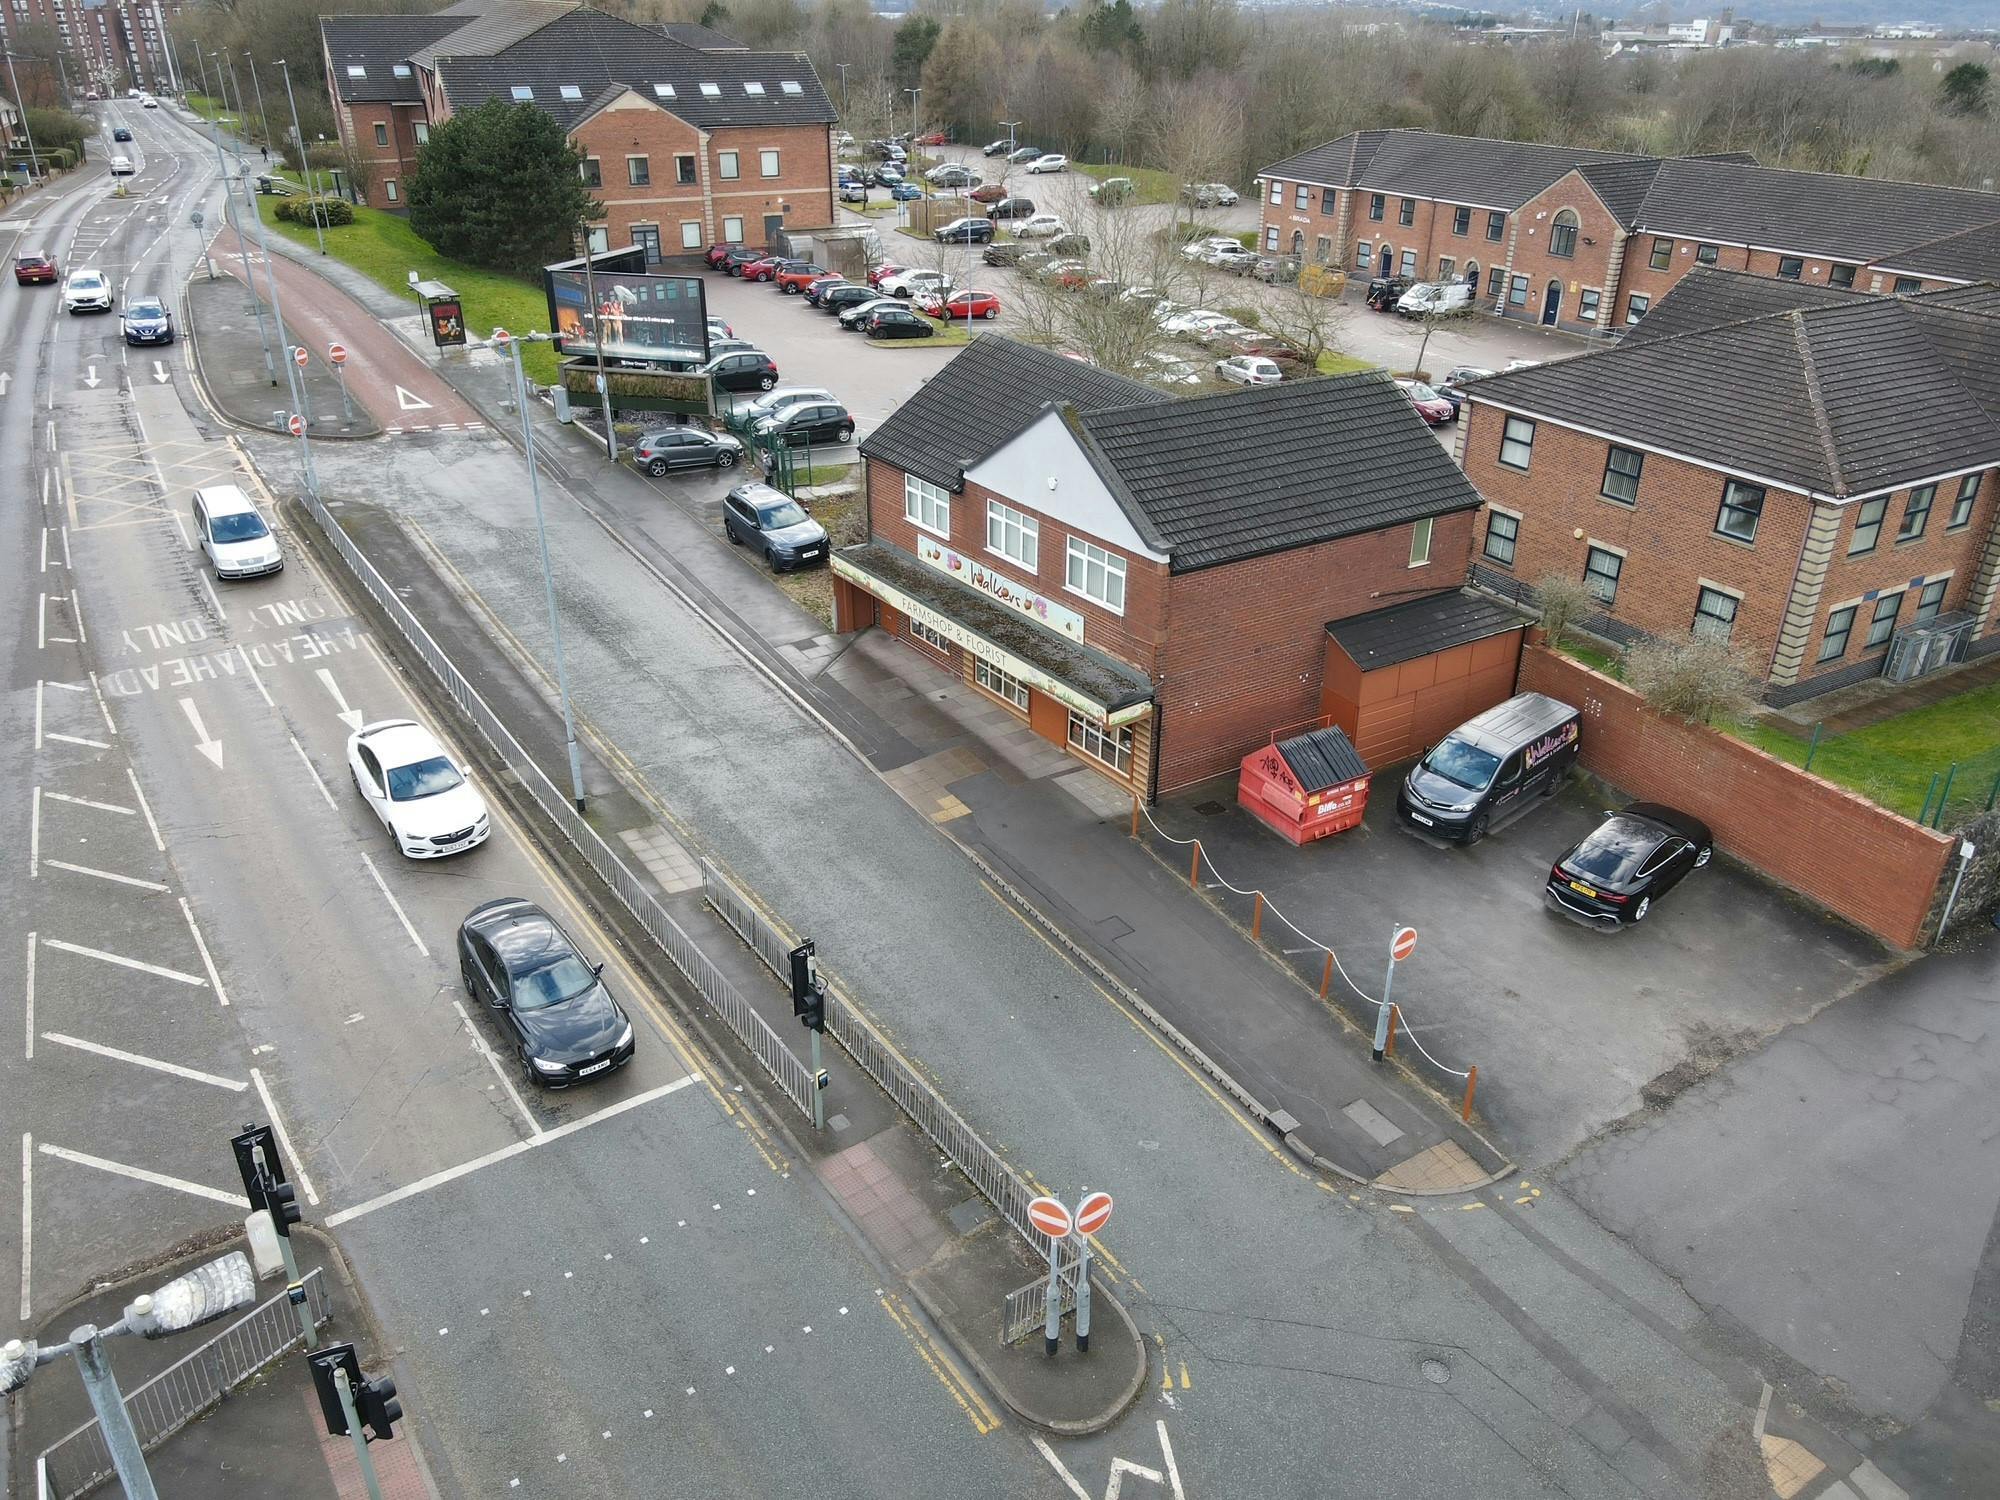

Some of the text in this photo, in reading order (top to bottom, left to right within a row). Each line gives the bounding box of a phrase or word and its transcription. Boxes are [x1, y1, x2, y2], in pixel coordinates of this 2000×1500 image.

[970, 562, 1021, 608] Walkers
[120, 618, 208, 655] ONLY
[247, 599, 326, 632] ONLY
[902, 598, 1007, 667] FARMSHOP & FLORIST
[250, 626, 358, 668] AHEAD
[110, 651, 236, 696] AHEAD
